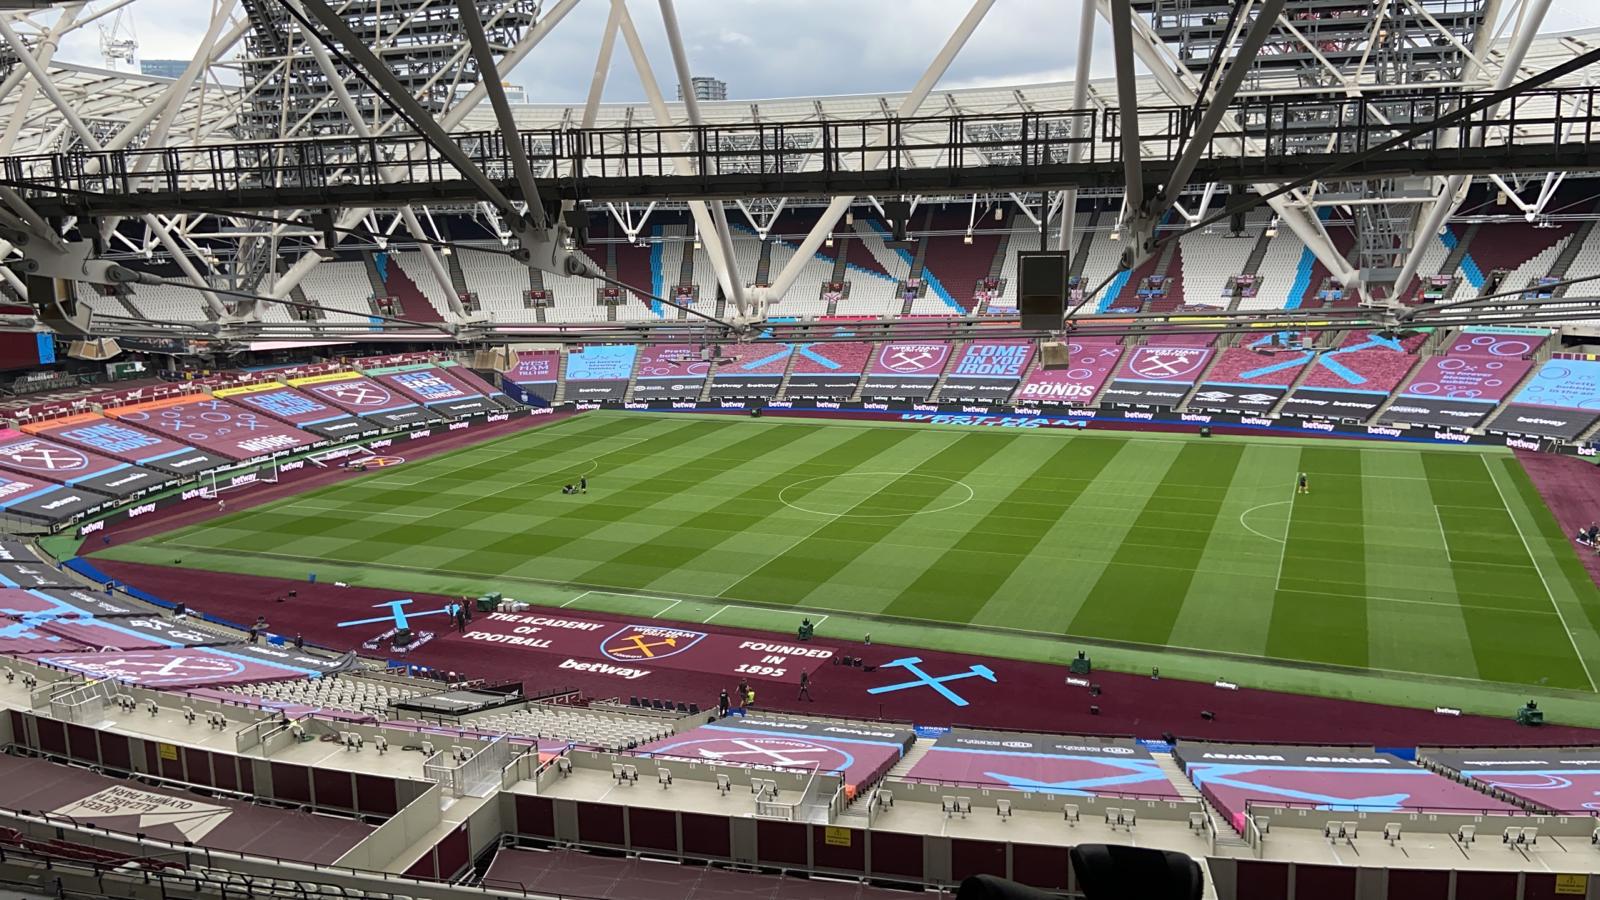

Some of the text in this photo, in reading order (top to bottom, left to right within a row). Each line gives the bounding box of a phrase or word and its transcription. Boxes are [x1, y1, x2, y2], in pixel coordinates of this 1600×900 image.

[966, 345, 1030, 357] COME
[962, 356, 1025, 364] ON YOU
[956, 364, 1022, 374] IRONS
[401, 377, 447, 388] EAST
[417, 383, 457, 395] EAST
[1022, 383, 1095, 396] BONDS
[422, 390, 464, 400] LONDON
[864, 402, 888, 411] betway
[1288, 398, 1329, 406] betway
[1333, 401, 1376, 409] betway
[914, 404, 938, 412] betway
[963, 406, 988, 414] betway
[1015, 407, 1041, 416] betway
[1068, 409, 1096, 418] betway
[487, 414, 509, 422] betway
[1125, 411, 1154, 420] betway
[1181, 413, 1211, 423] betway
[1517, 416, 1567, 426] betway
[449, 421, 469, 431] betway
[930, 418, 1040, 428] UNITED
[998, 417, 1087, 427] HAM
[1241, 416, 1272, 427] betway
[1302, 421, 1335, 432] betway
[410, 429, 430, 439] betway
[1368, 426, 1401, 437] betway
[1434, 431, 1470, 443] betway
[237, 434, 301, 452] MOORE
[371, 439, 392, 449] betway
[1506, 437, 1540, 451] betway
[1578, 446, 1596, 456] bet
[280, 460, 304, 472] betway
[232, 473, 257, 485] betway
[182, 486, 209, 500] betway
[129, 502, 156, 518] betway
[81, 520, 104, 535] betway
[487, 612, 604, 632] THE ACADEMY
[513, 625, 542, 635] OF
[462, 631, 552, 648] FOOTBALL
[739, 641, 832, 658] FOUNDED
[761, 656, 786, 664] IN
[558, 659, 651, 679] betway
[734, 664, 787, 677] 1895
[739, 719, 808, 729] betway
[824, 726, 896, 737] betway
[92, 793, 159, 812] ELIZABETH
[109, 787, 192, 810] OLYMPIC PARK
[76, 799, 119, 813] QUEEN
